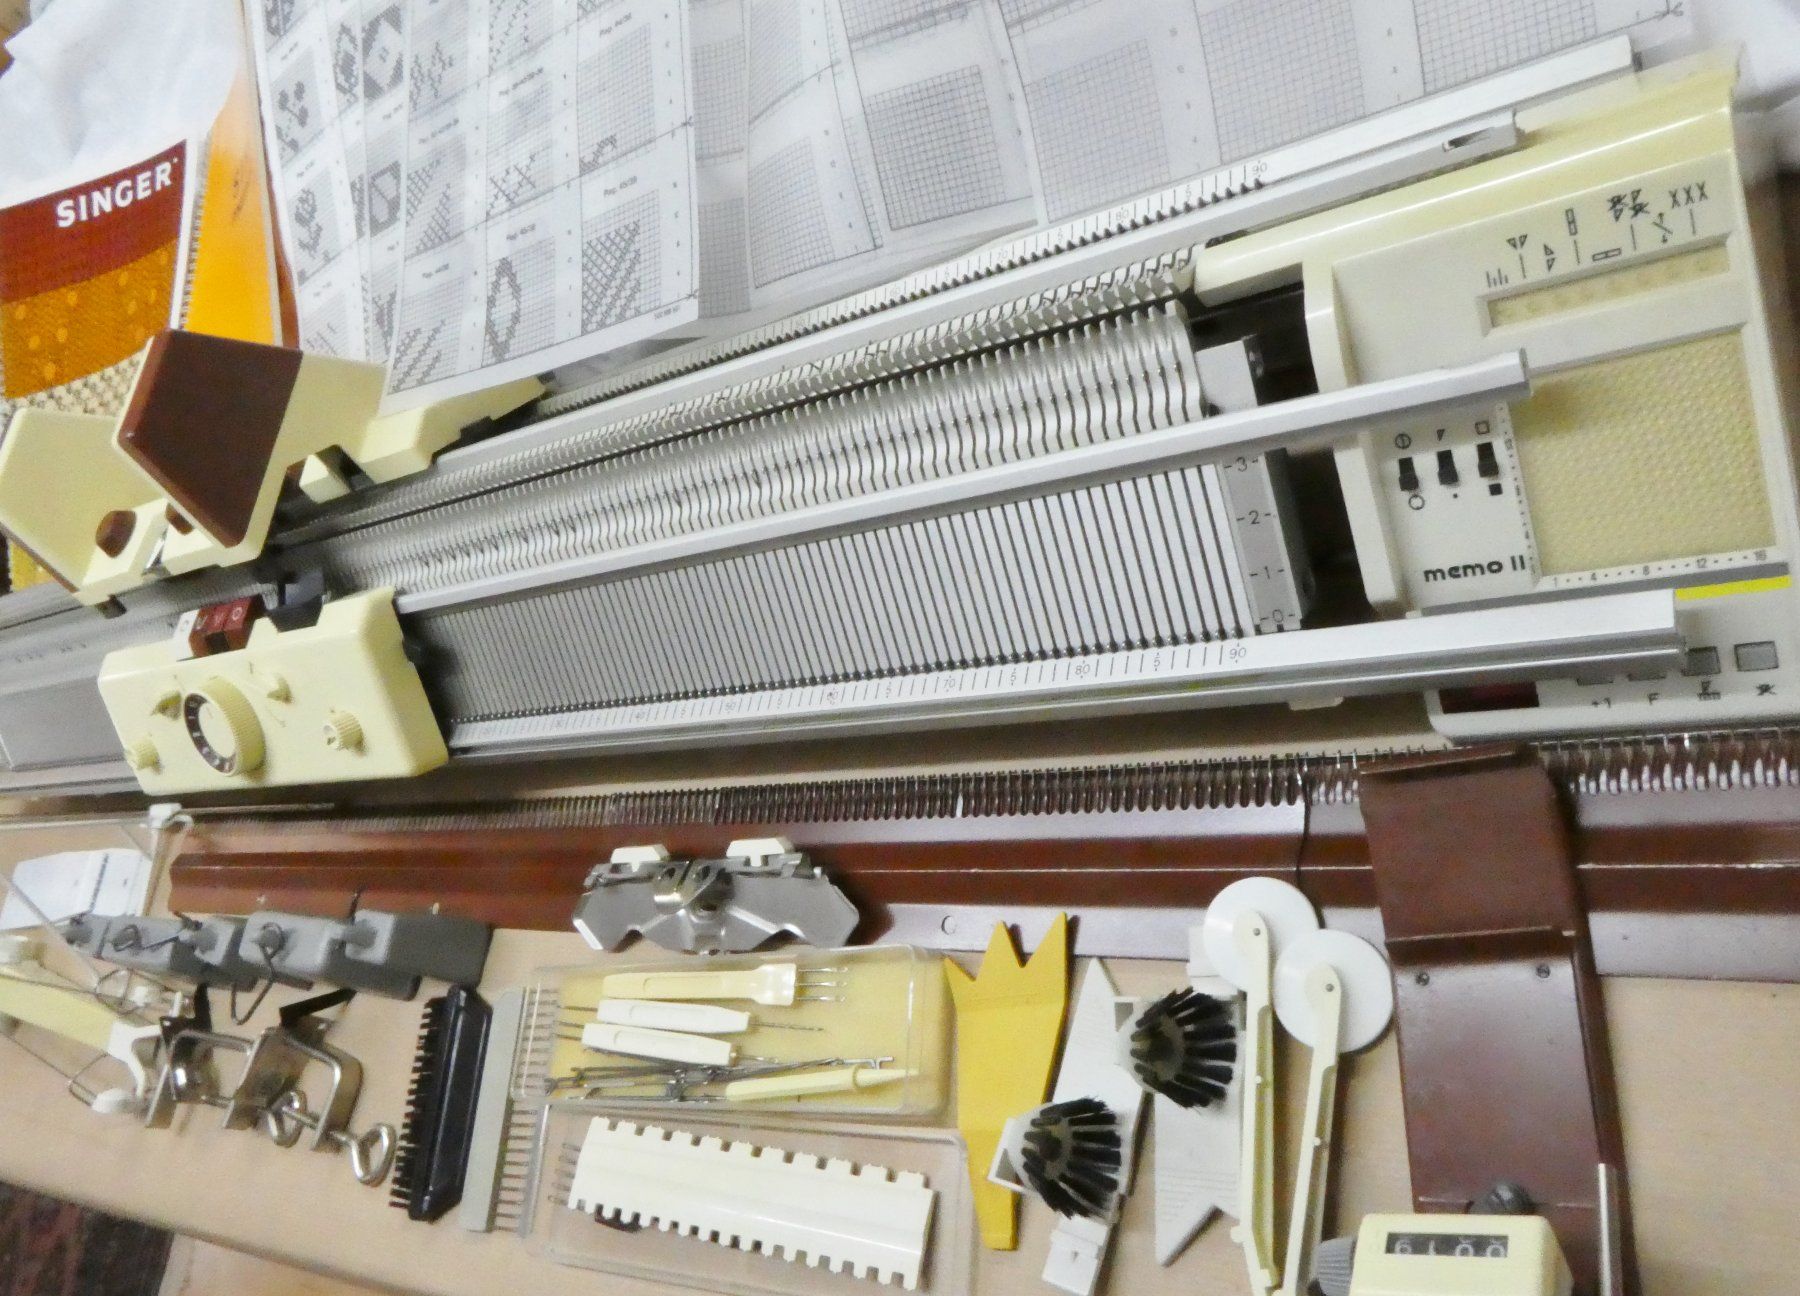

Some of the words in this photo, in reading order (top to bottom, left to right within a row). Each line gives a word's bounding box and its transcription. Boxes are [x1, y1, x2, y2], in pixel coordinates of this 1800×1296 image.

[1251, 162, 1268, 175] 90
[56, 161, 172, 228] SINGER
[1248, 510, 1261, 525] 2
[1423, 561, 1504, 582] memo
[1074, 663, 1091, 676] 80
[1229, 646, 1247, 660] 90
